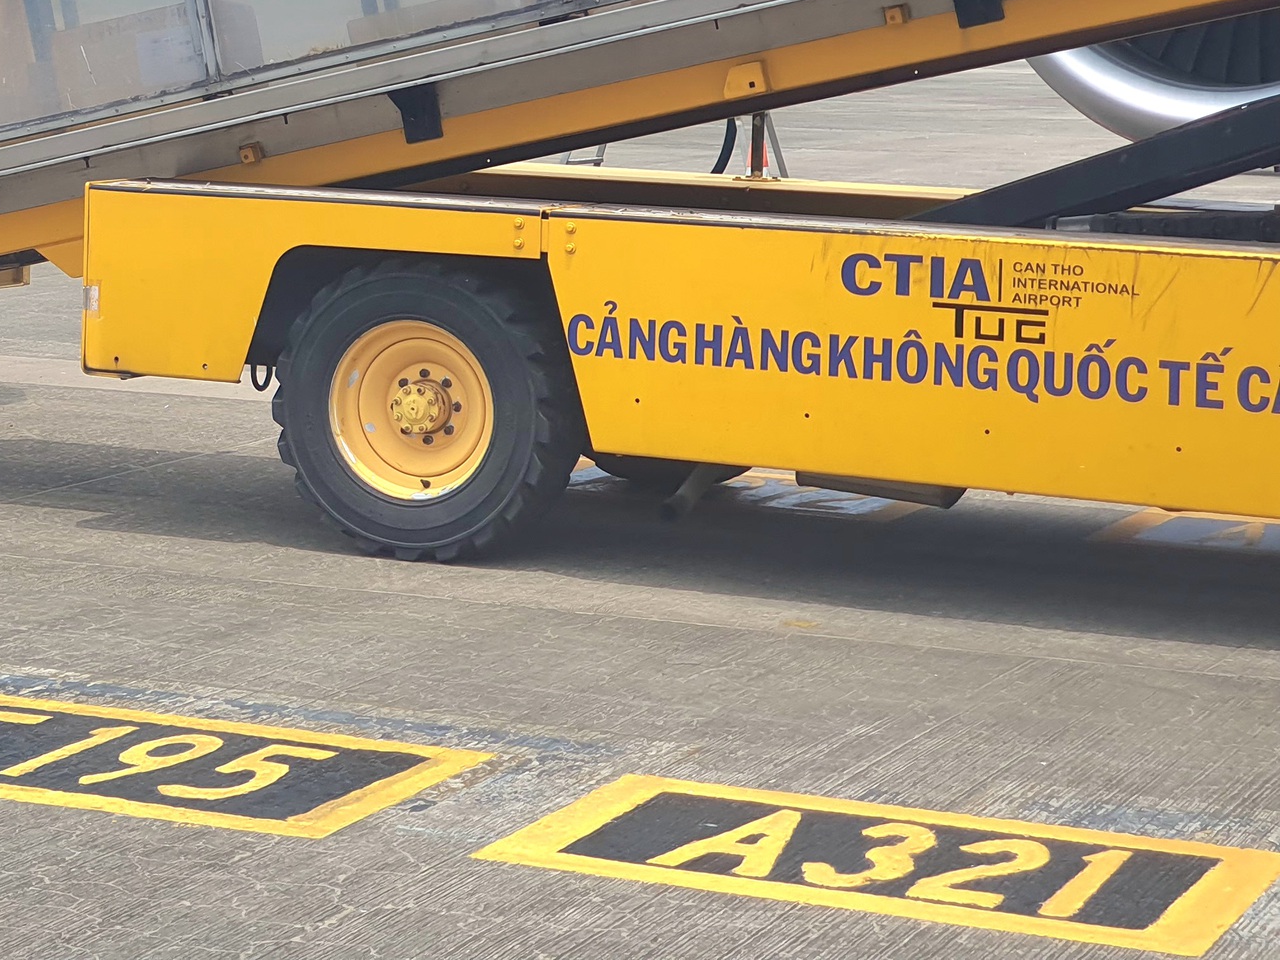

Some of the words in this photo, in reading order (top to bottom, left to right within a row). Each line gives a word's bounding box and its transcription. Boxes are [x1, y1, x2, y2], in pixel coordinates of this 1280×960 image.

[841, 253, 991, 302] CTIA
[1012, 261, 1047, 275] CAN
[1051, 263, 1084, 277] THO
[1012, 277, 1140, 297] INTERNATIONAL
[1011, 292, 1083, 308] AIRPORT
[1006, 338, 1149, 404] QUỐC
[1158, 347, 1234, 410] TẾ
